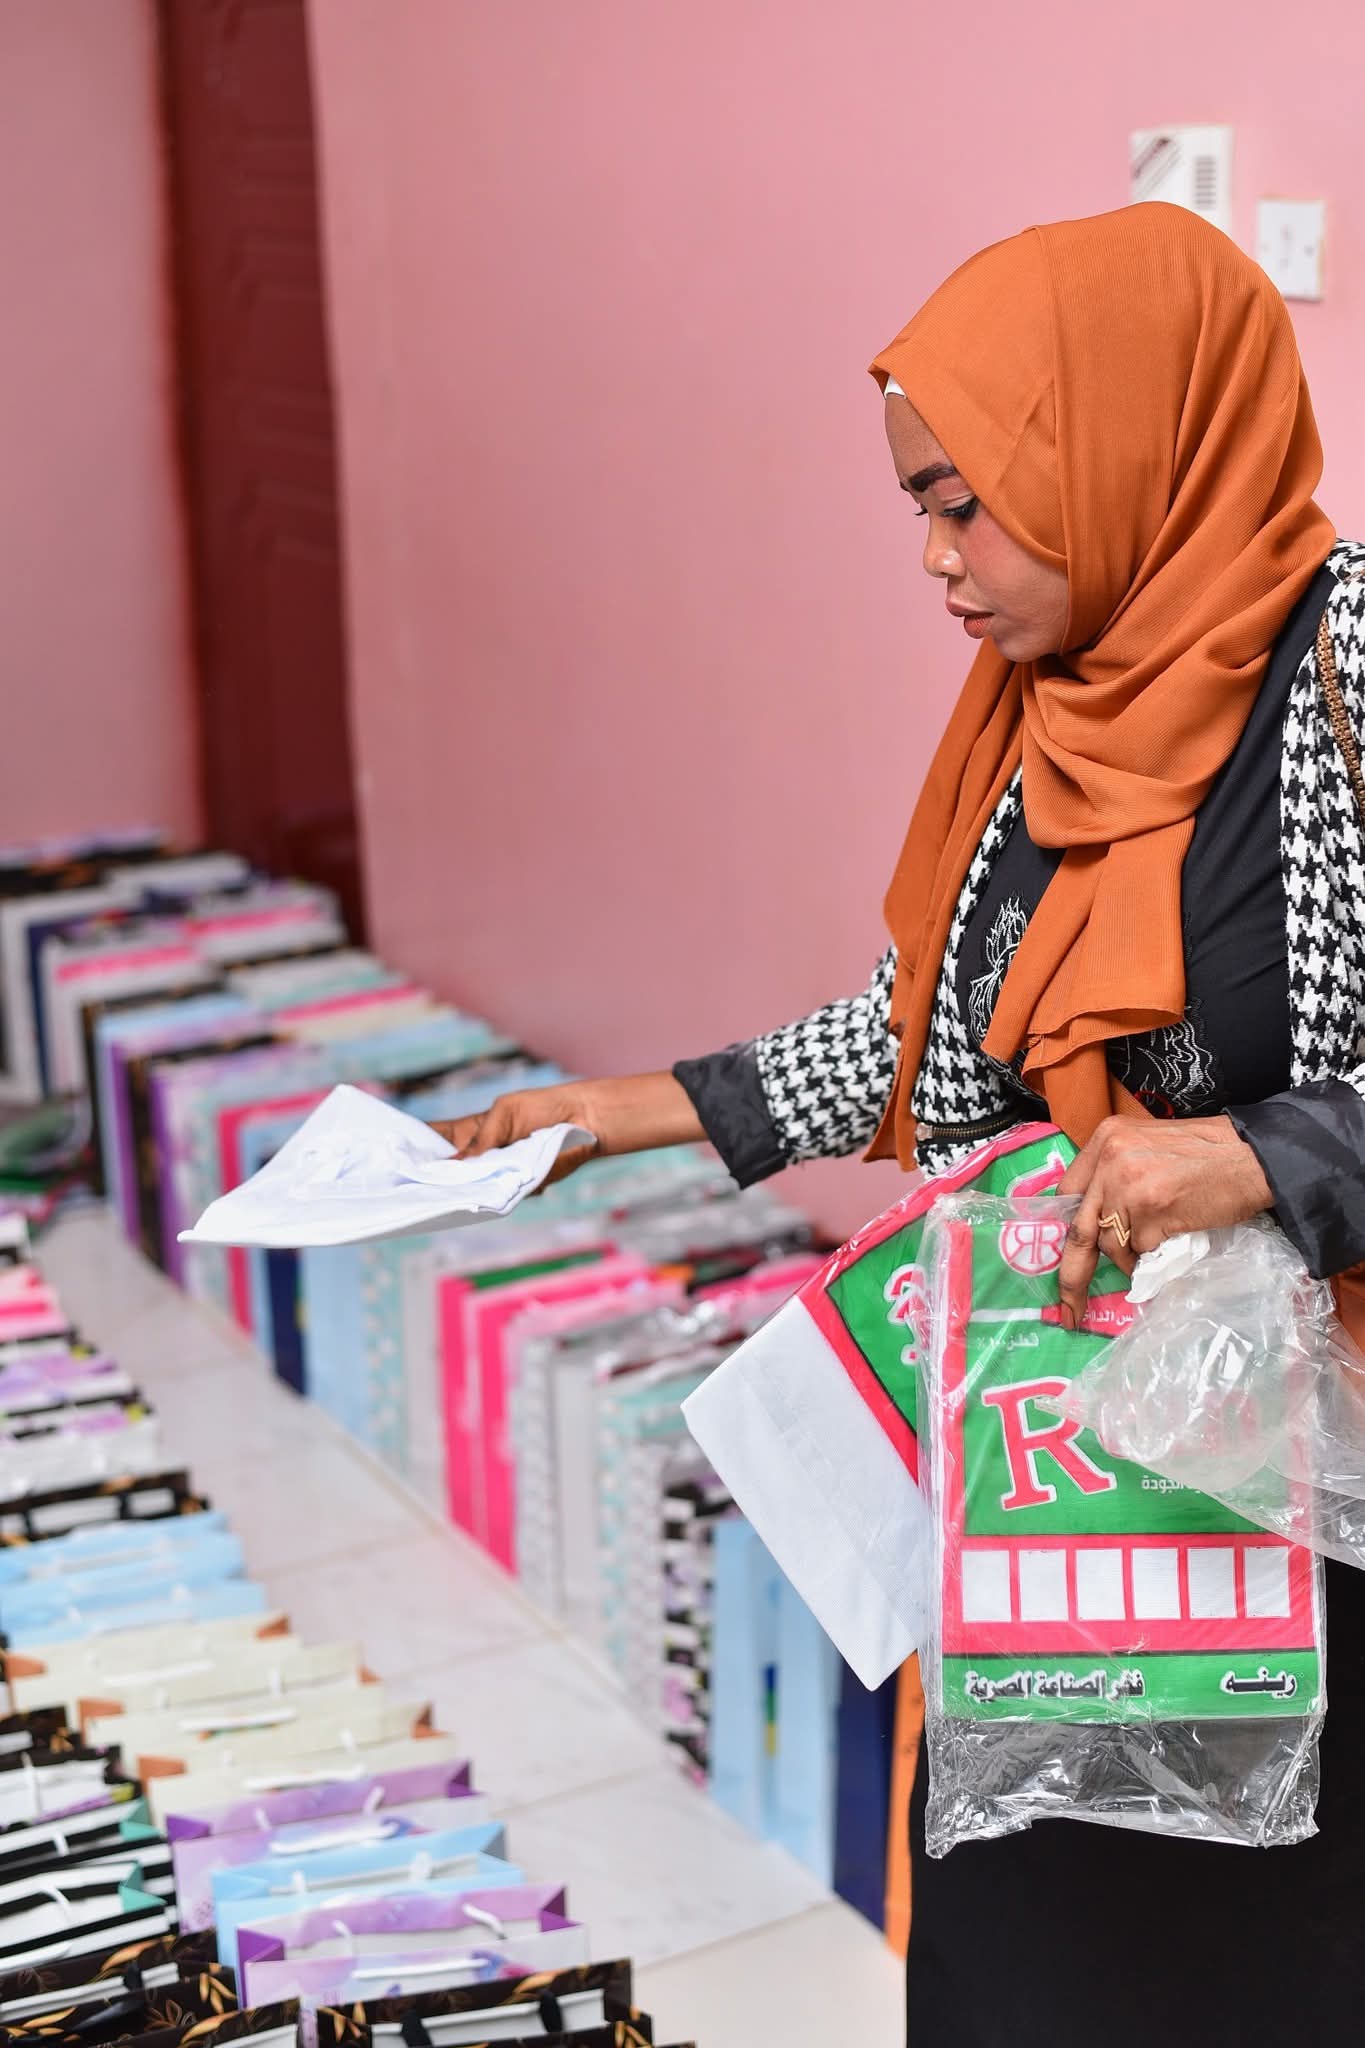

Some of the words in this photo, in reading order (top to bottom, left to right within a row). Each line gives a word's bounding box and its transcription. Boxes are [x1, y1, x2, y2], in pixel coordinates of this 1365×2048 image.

[980, 1375, 1117, 1511] R
[965, 1670, 1033, 1703] المصرية
[1034, 1670, 1107, 1699] الصناعة
